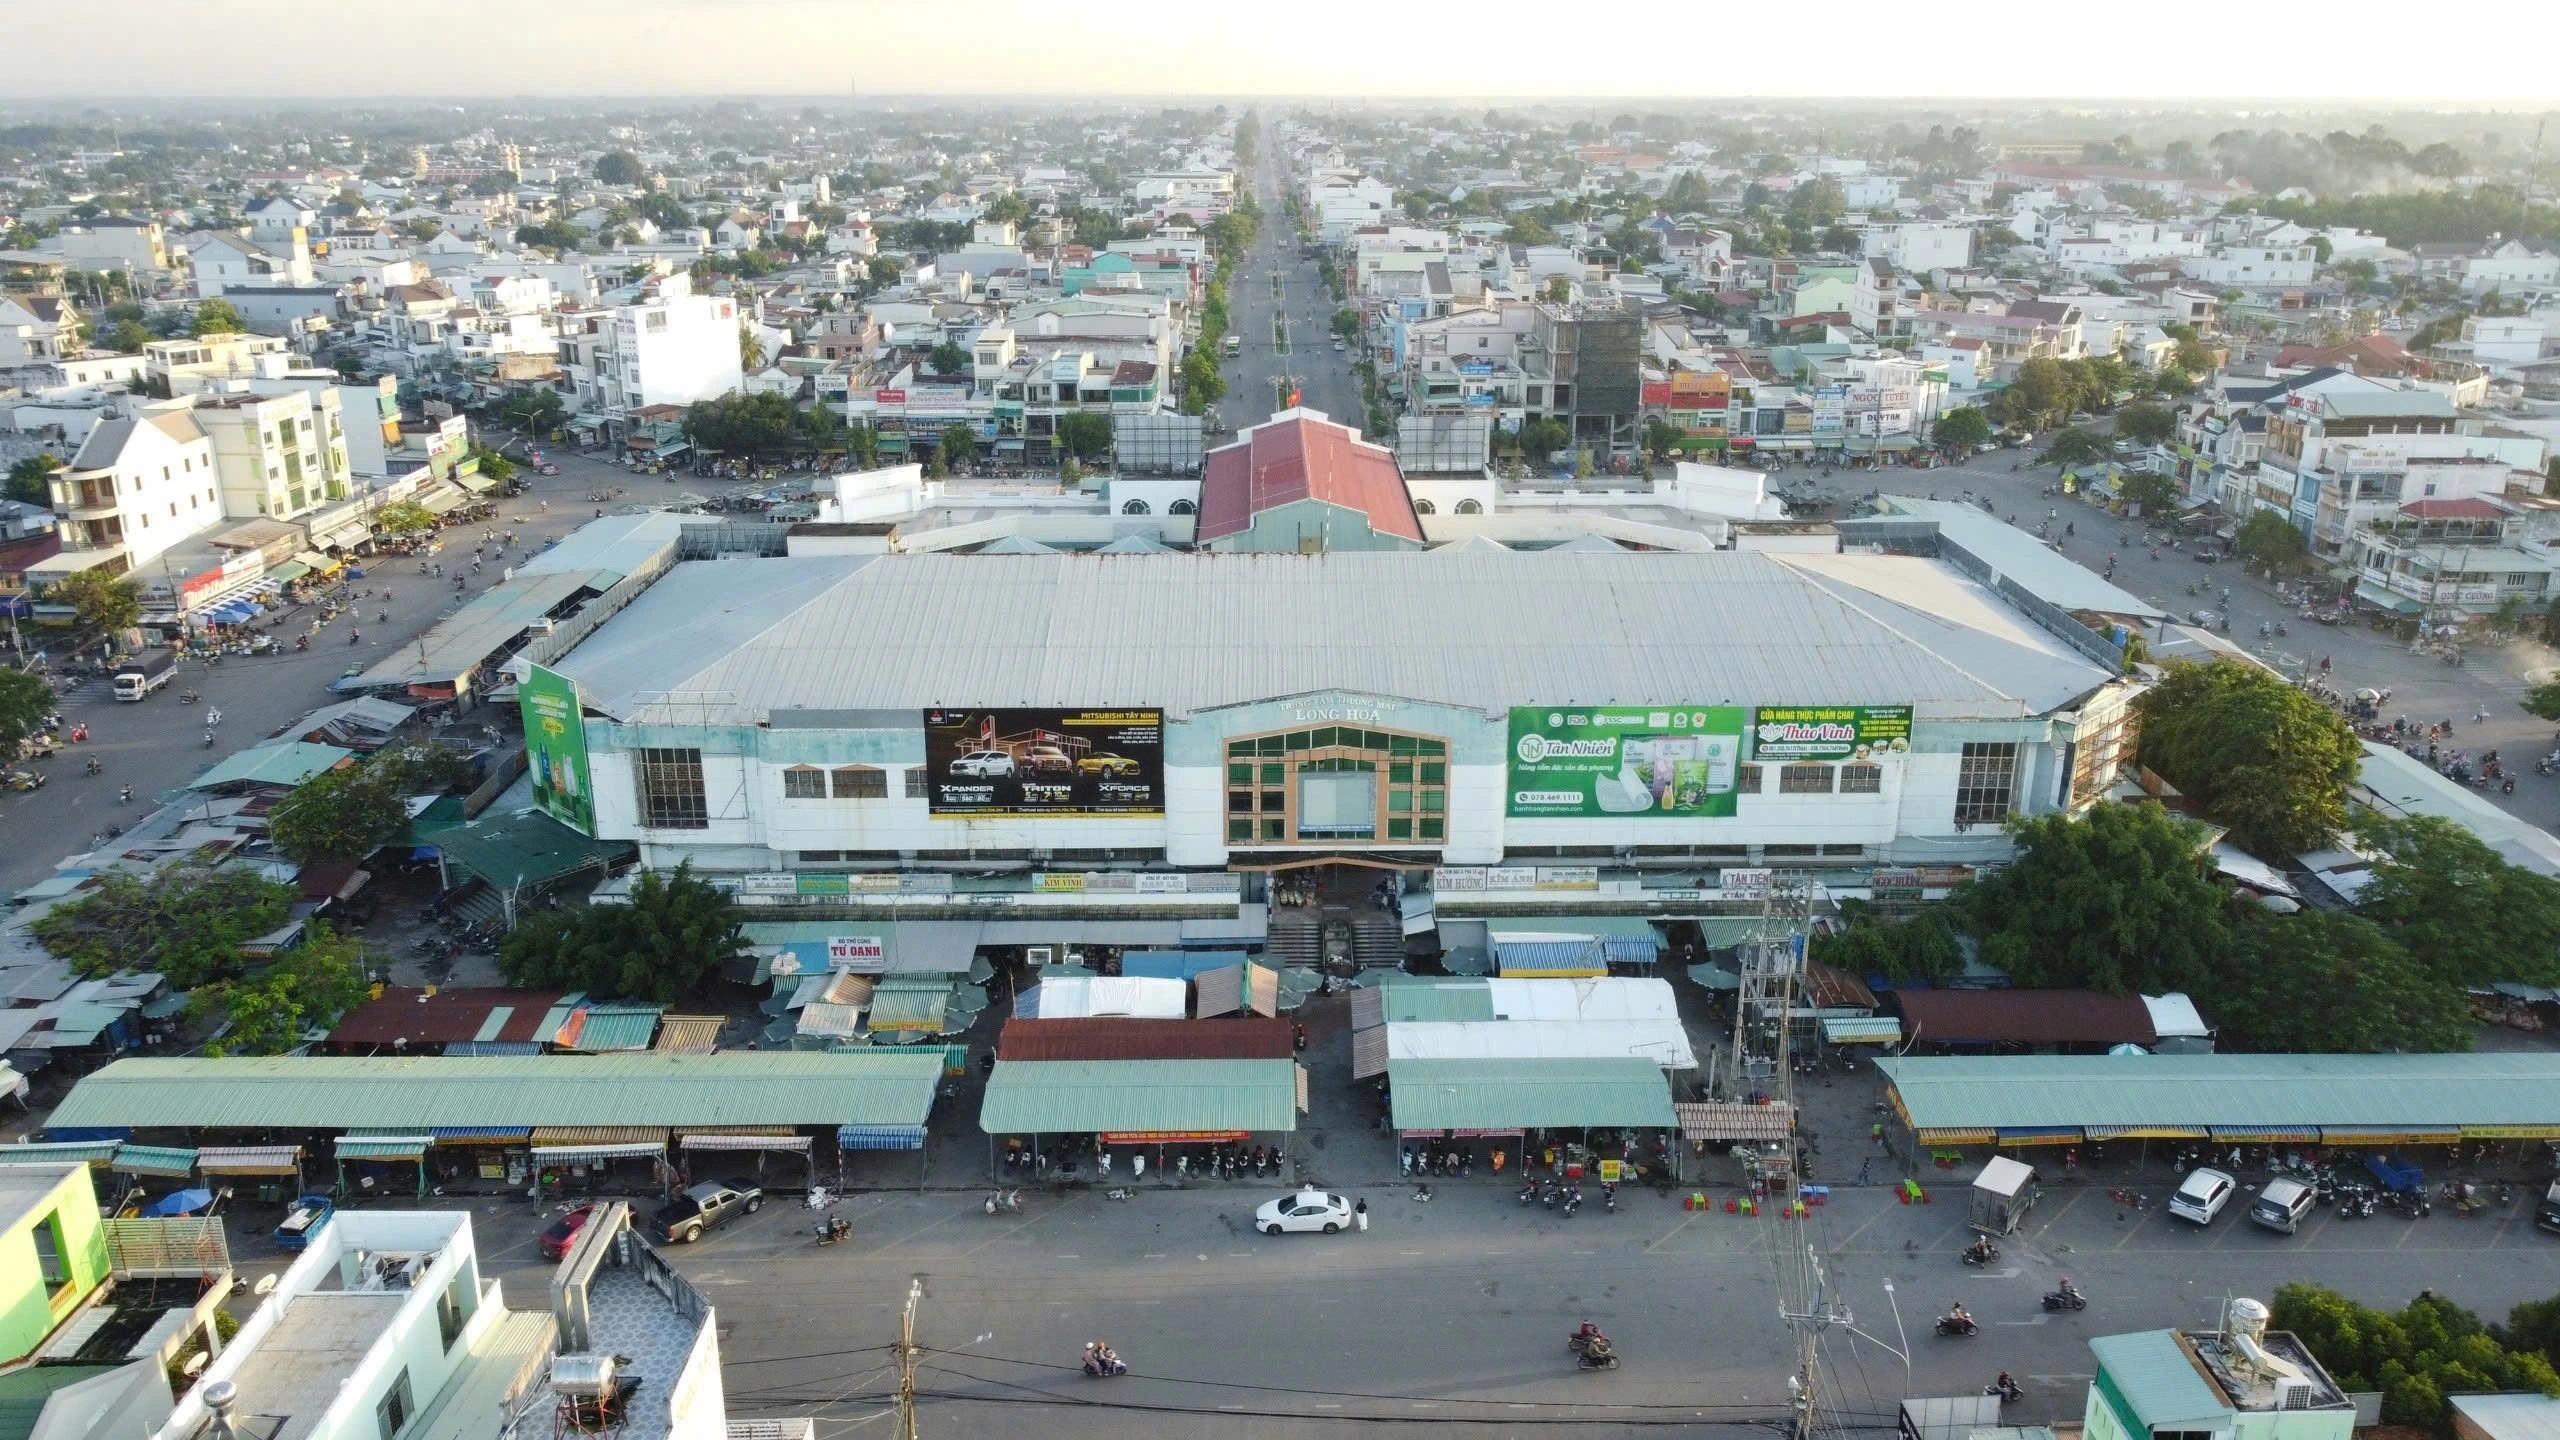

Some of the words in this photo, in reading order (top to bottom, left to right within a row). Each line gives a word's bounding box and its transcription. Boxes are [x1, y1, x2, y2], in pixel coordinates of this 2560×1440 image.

[1126, 711, 1140, 719] TÂY
[1295, 709, 1341, 721] LONG
[1760, 708, 1775, 720] CỬA
[1775, 709, 1796, 720] HÀNG
[1796, 710, 1815, 722] THỰC
[1836, 710, 1856, 720] CHAY
[1782, 723, 1817, 739] Thảo
[1818, 723, 1854, 739] Vinh
[1547, 742, 1568, 755] Tân
[1572, 742, 1612, 755] Nhiên
[1045, 879, 1060, 887] KIM
[1063, 879, 1082, 887] VINH
[850, 946, 881, 957] OANH
